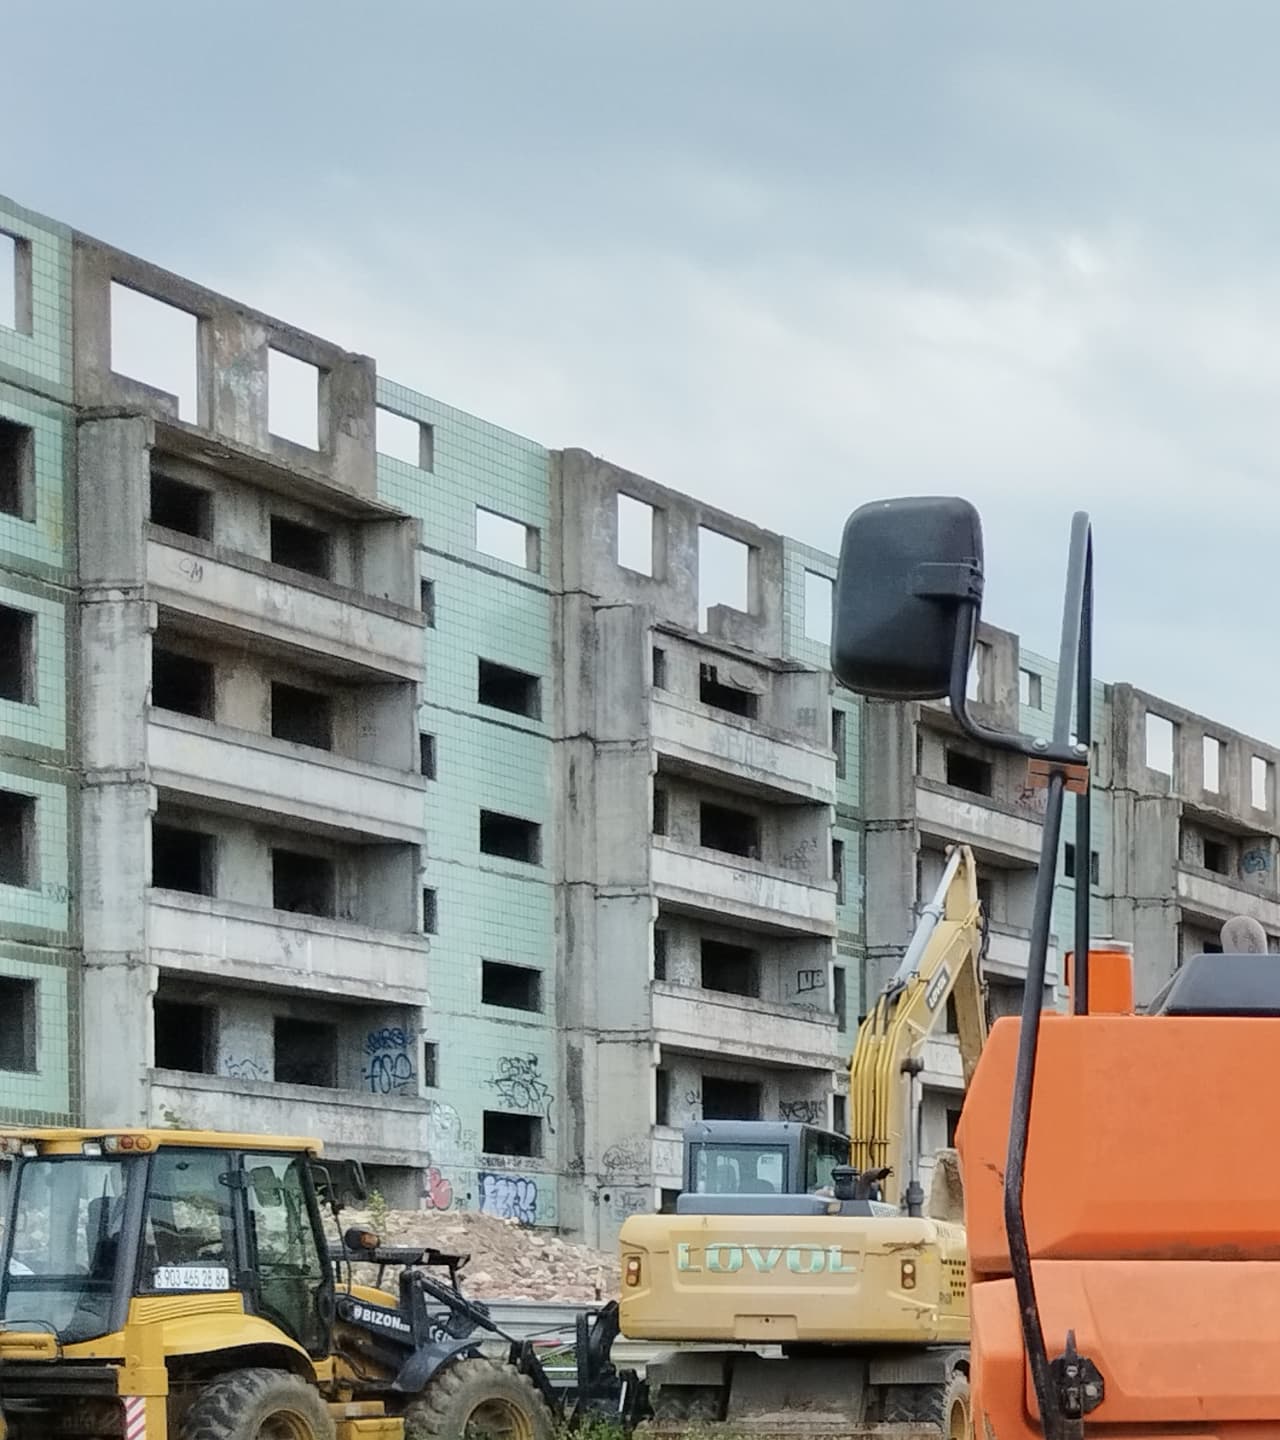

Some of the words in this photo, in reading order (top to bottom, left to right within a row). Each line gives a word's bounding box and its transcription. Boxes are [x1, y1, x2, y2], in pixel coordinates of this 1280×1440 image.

[677, 1242, 857, 1274] LOVOL
[165, 1268, 181, 1287] 903
[361, 1308, 401, 1330] BIZON
